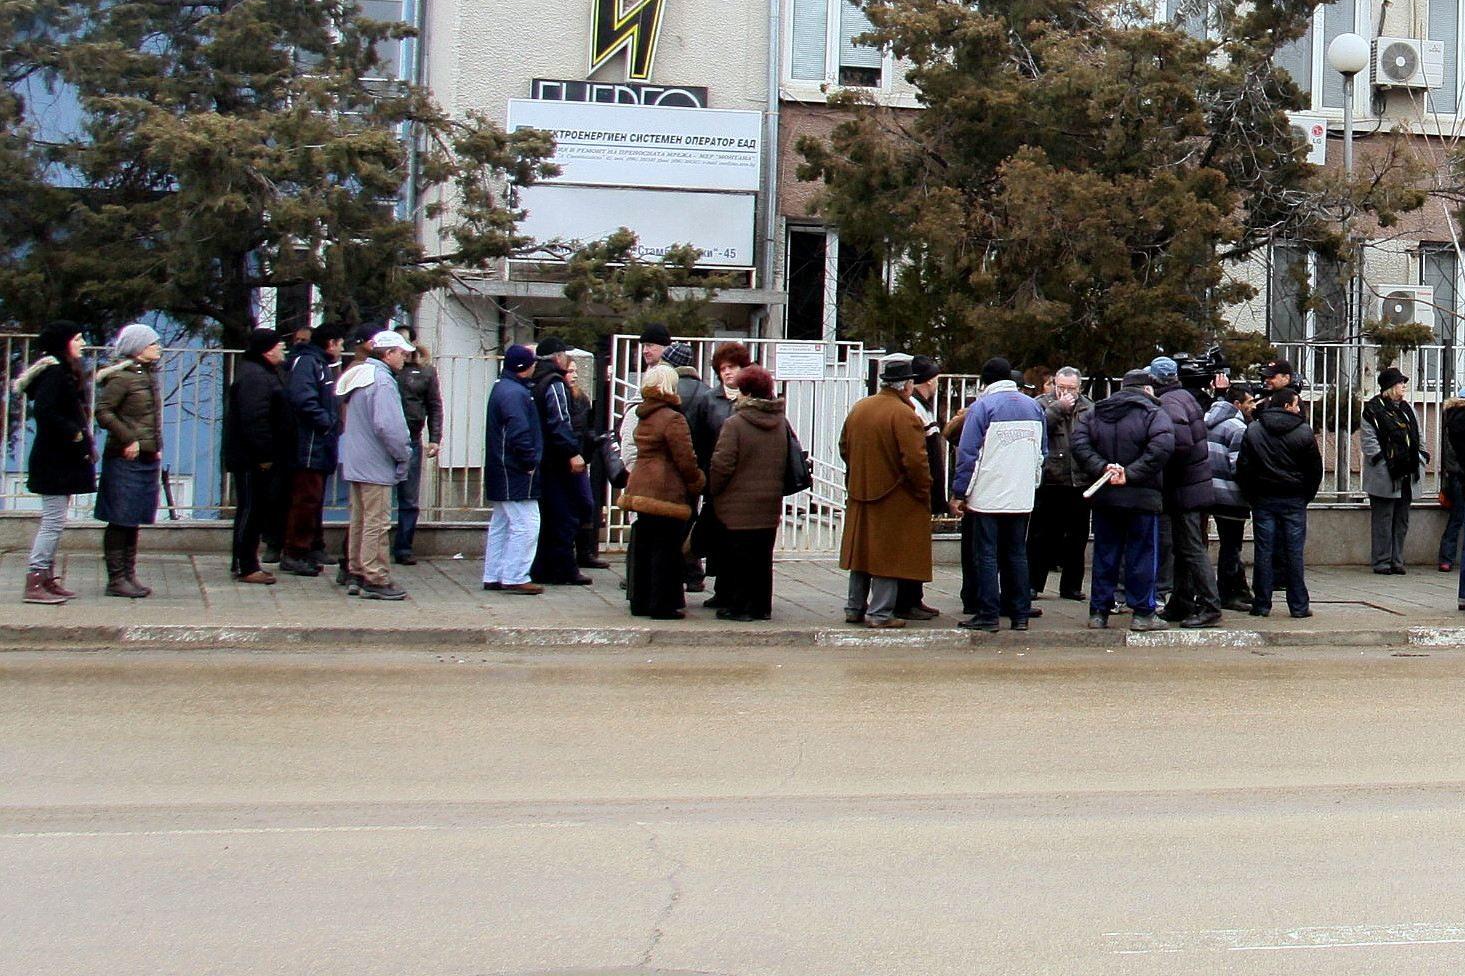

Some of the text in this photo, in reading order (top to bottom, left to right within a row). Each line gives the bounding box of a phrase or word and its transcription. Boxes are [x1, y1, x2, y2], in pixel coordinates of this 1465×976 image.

[535, 129, 756, 148] КТРОЕНЕРГИЕН СИСТЕМЕН ОПЕРАТОР ЕАД
